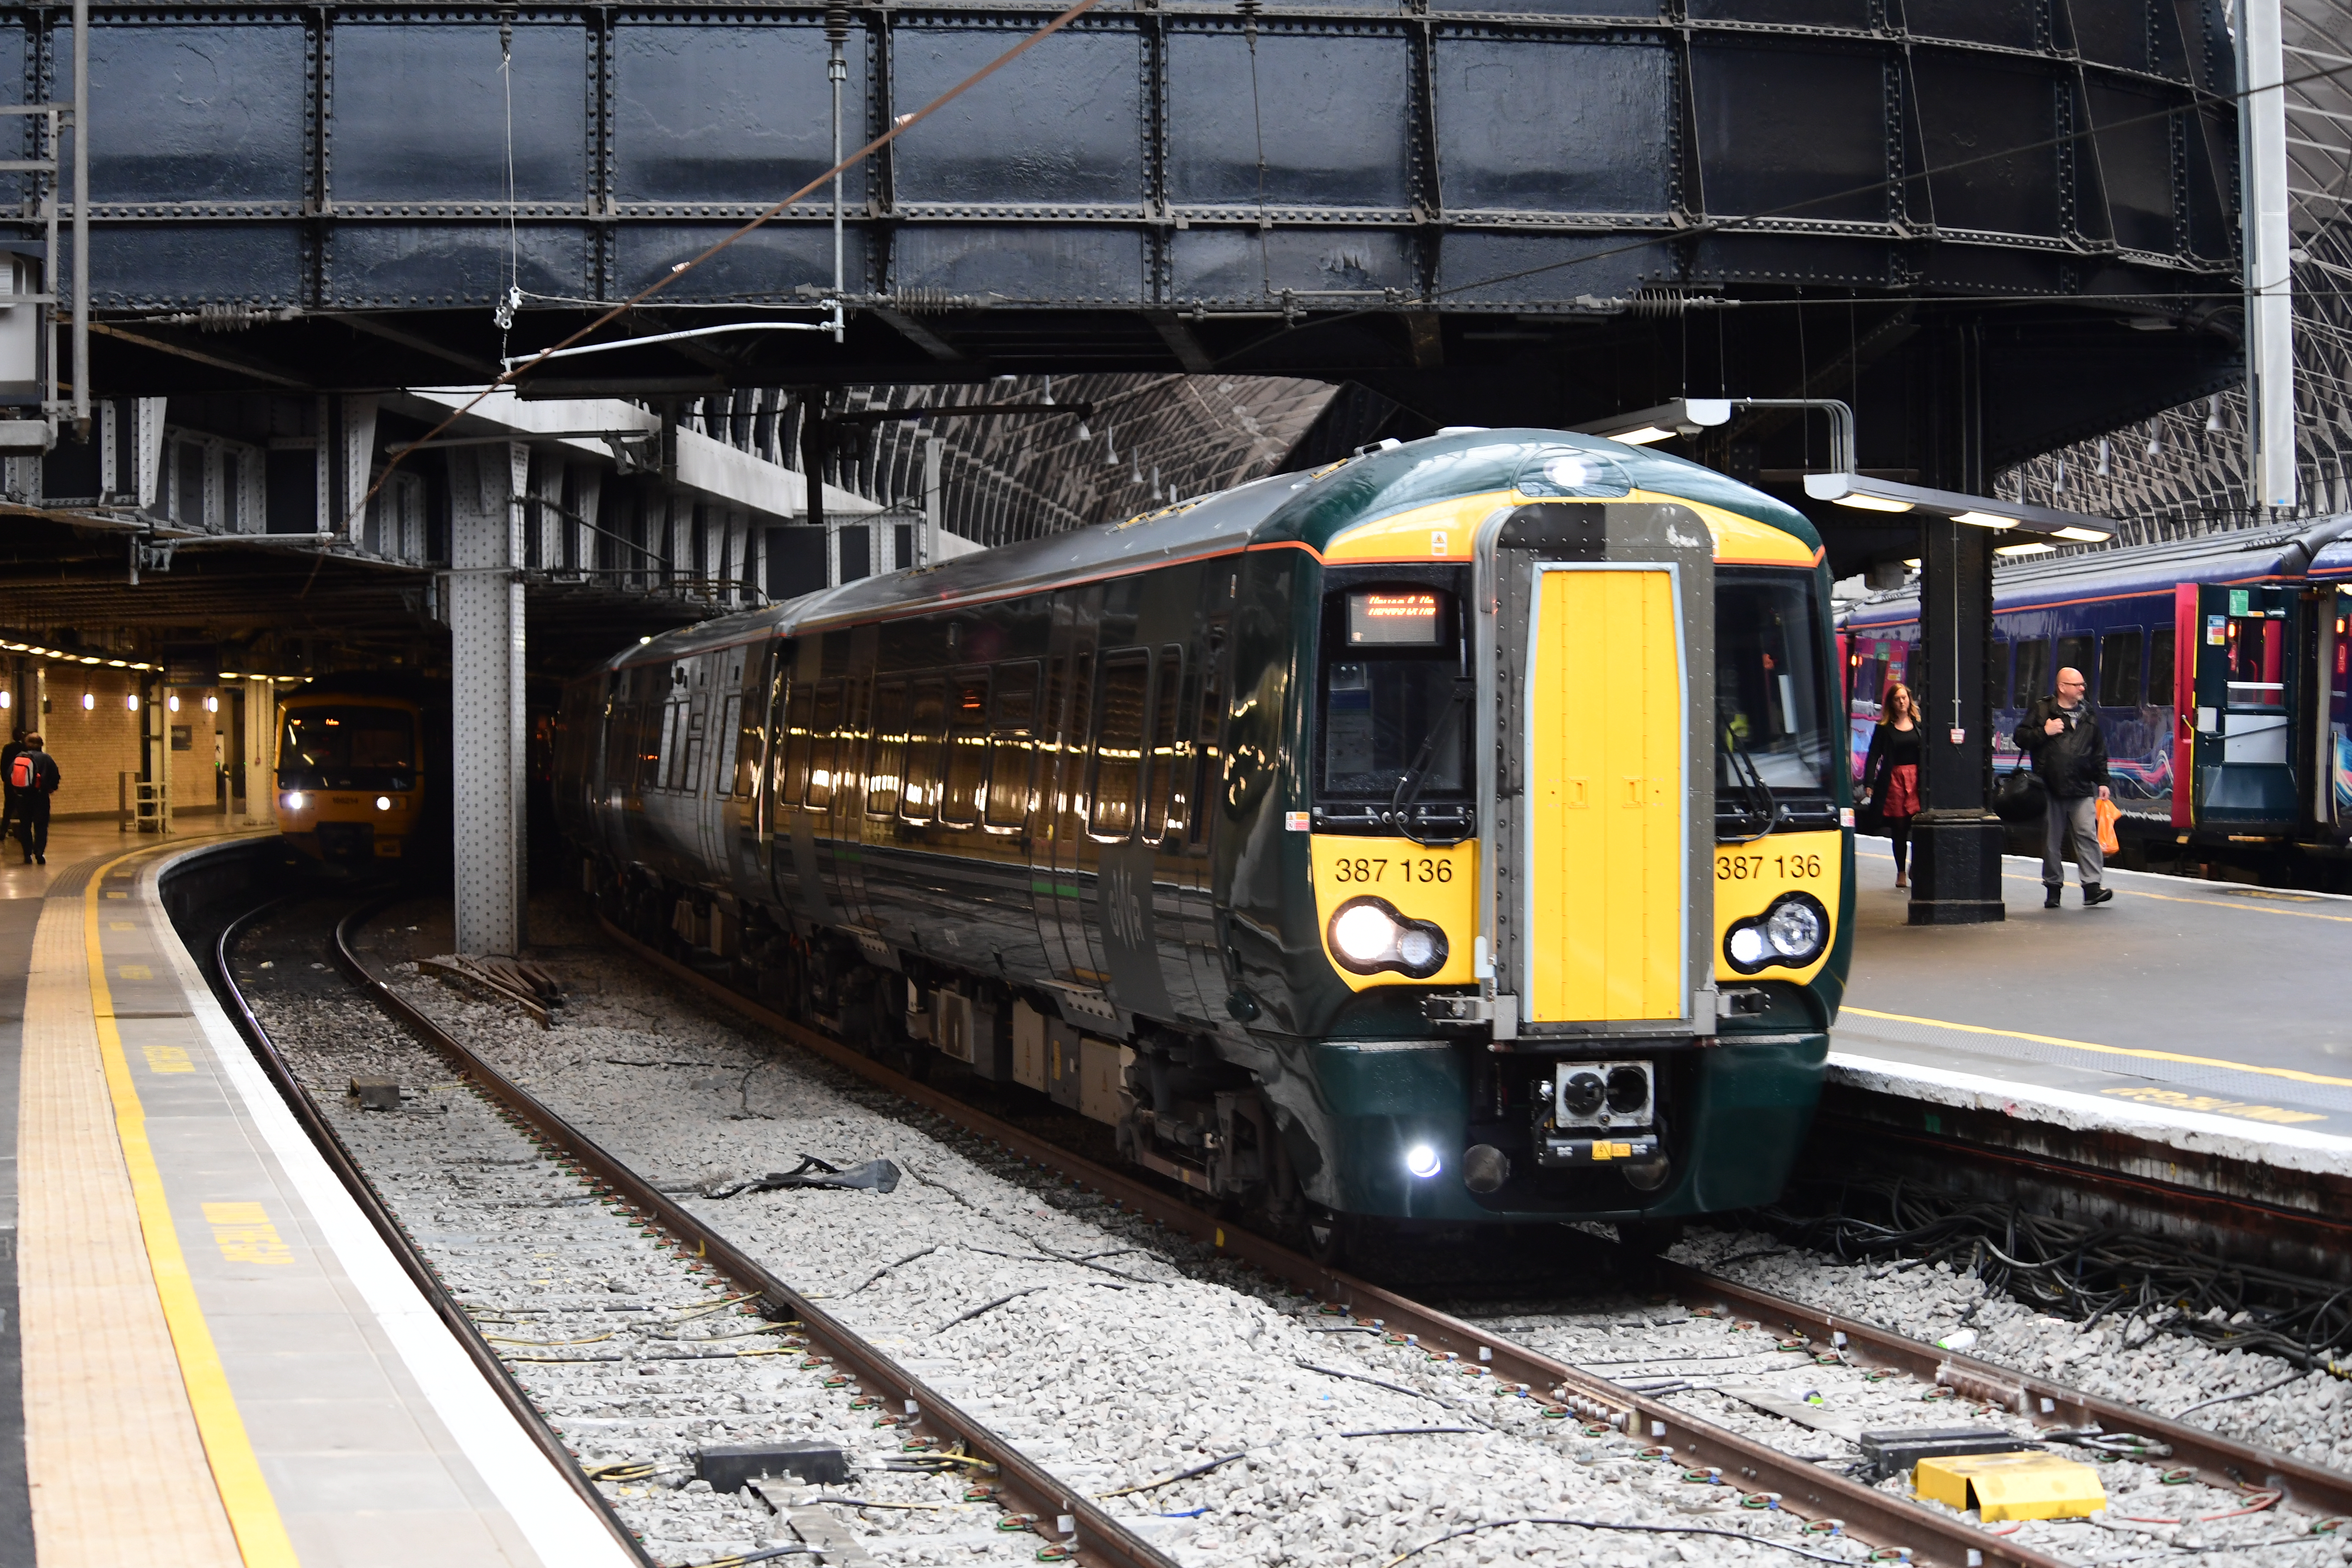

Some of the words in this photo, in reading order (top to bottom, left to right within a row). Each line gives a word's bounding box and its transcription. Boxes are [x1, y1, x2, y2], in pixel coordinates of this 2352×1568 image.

[1335, 858, 1388, 882] 387
[1399, 858, 1452, 882] 136
[1716, 856, 1763, 880] 387
[1774, 854, 1820, 878] 136
[1108, 858, 1145, 951] GWR
